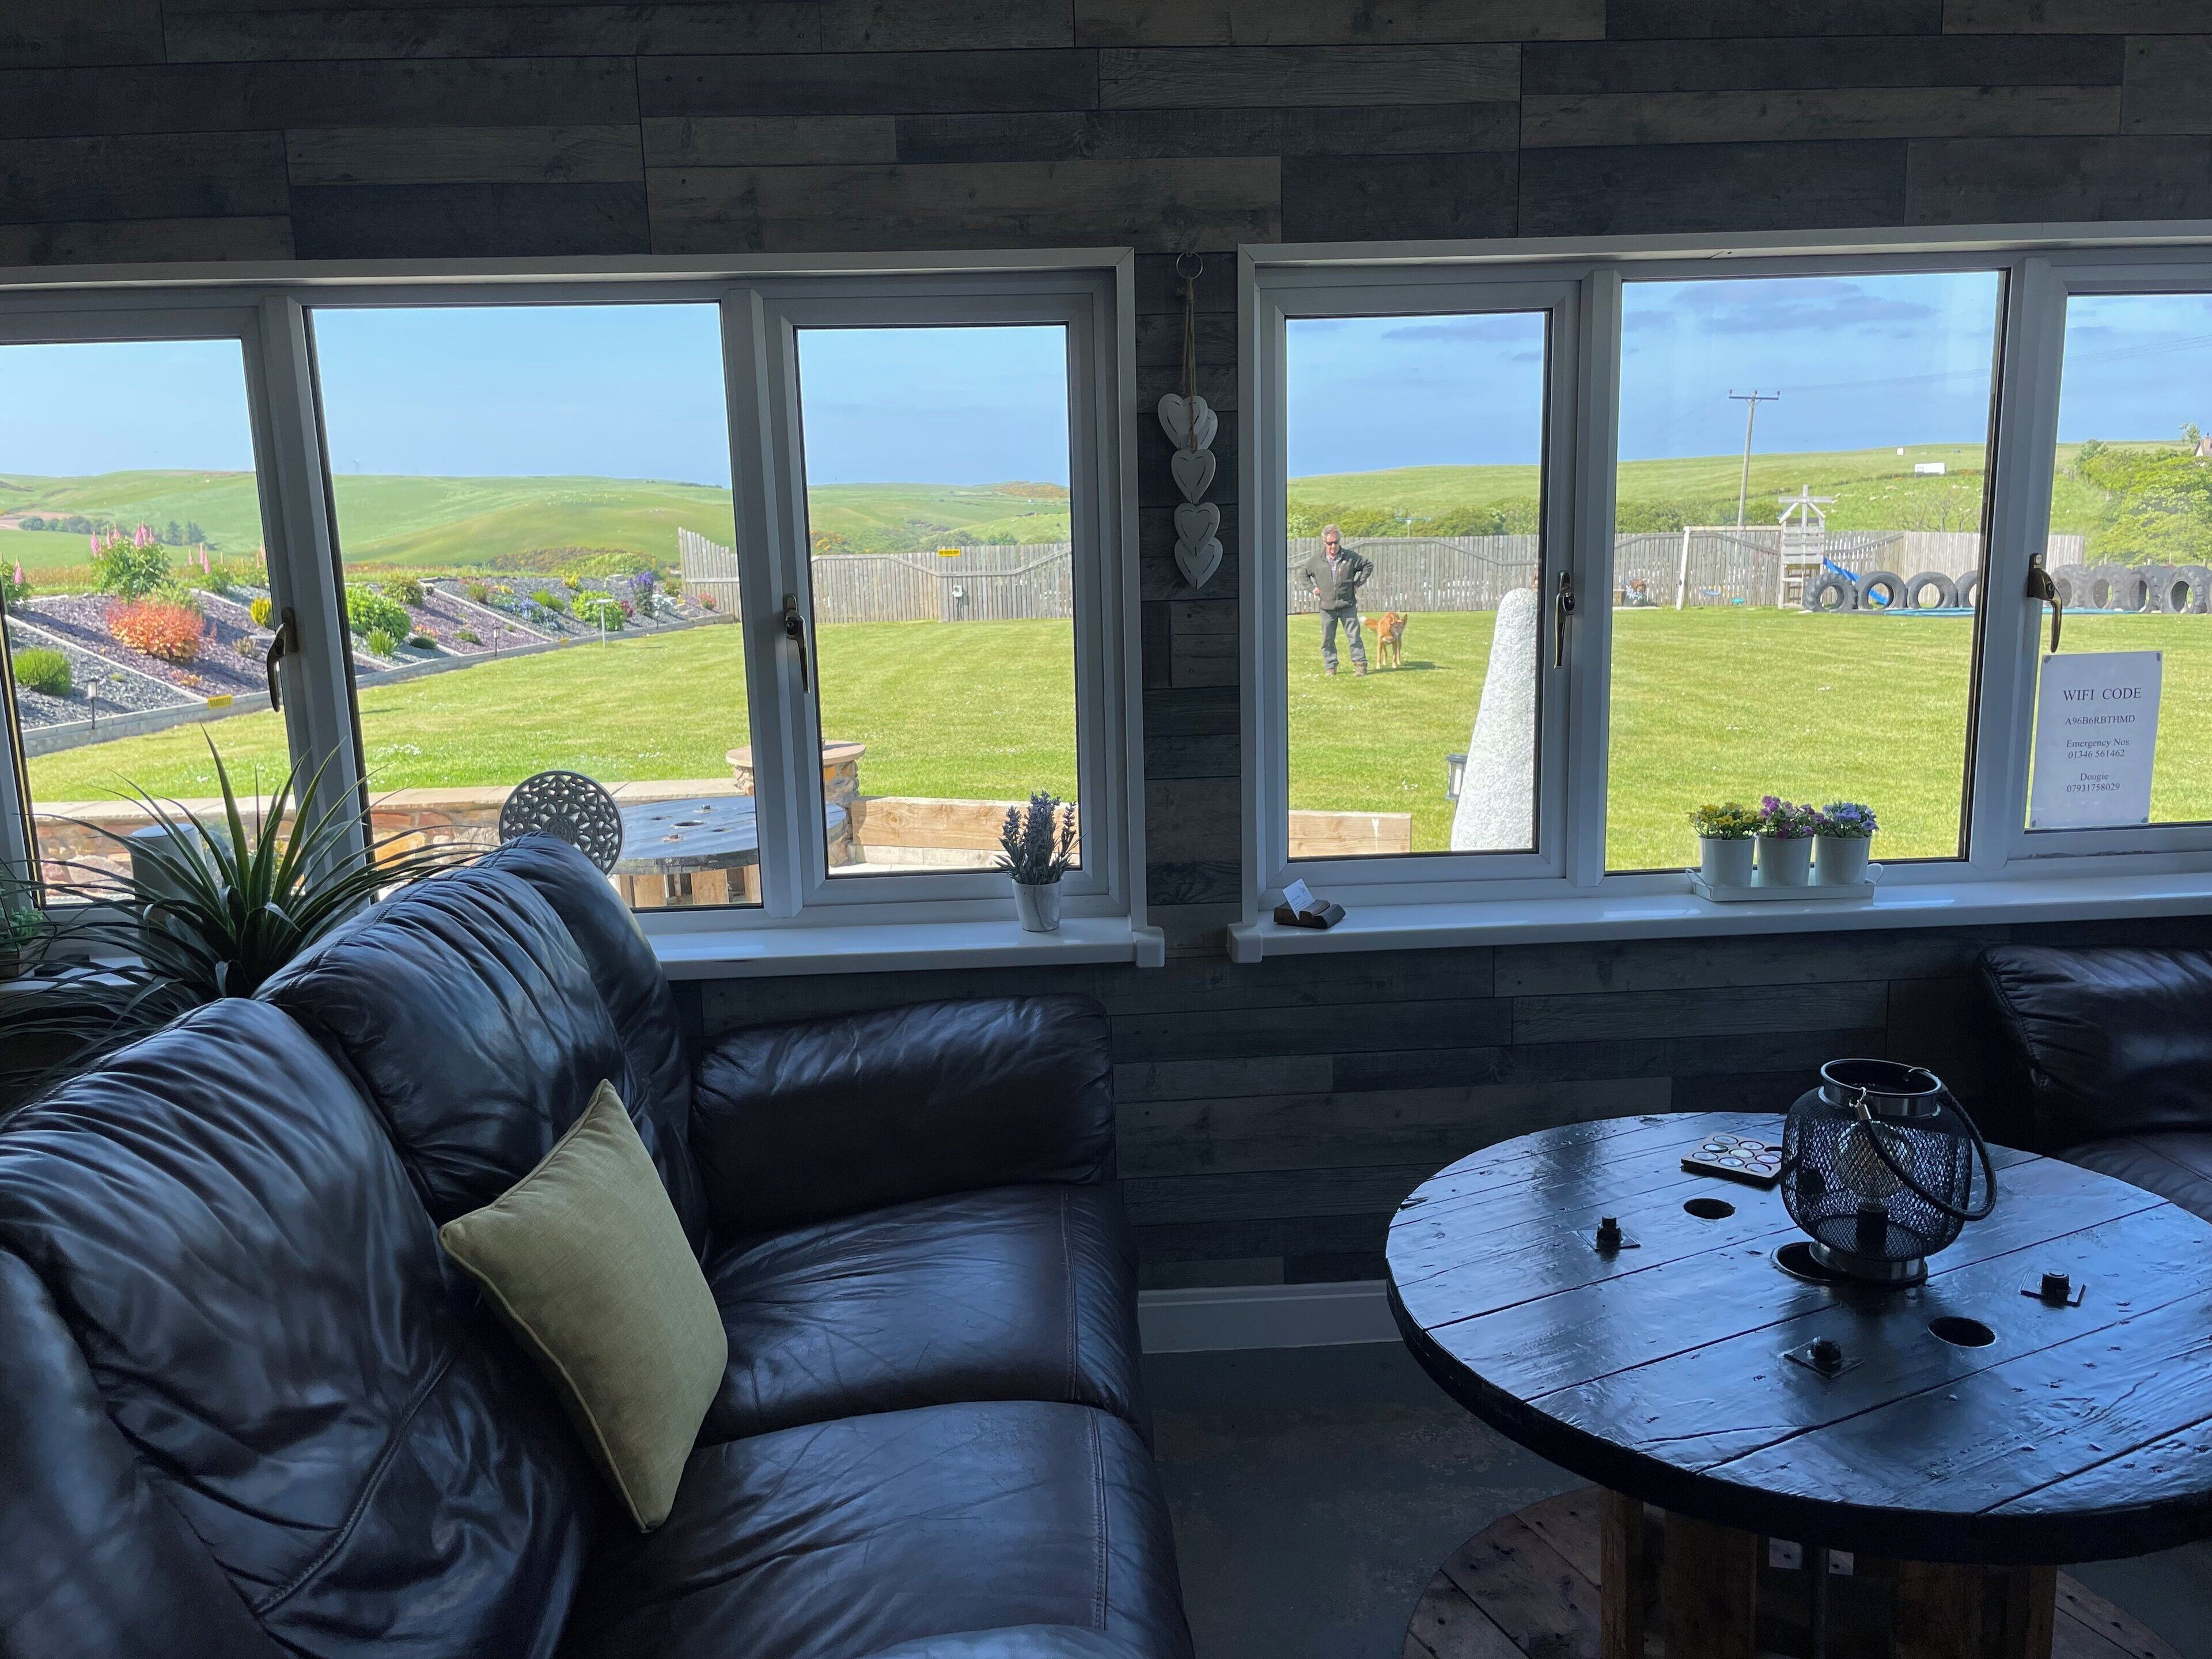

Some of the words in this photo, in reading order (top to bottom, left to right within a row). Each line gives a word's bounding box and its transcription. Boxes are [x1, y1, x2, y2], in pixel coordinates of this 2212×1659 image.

[2063, 690, 2094, 701] WIFI
[2103, 688, 2142, 700] CODE
[2065, 715, 2135, 725] A96B6RBTHMD
[2066, 739, 2111, 749] Emergency
[2113, 738, 2130, 746] Nos
[2068, 751, 2093, 759] 01346
[2094, 749, 2125, 757] 561462
[2080, 772, 2109, 782] Dougie
[2066, 783, 2120, 792] 07931758029
